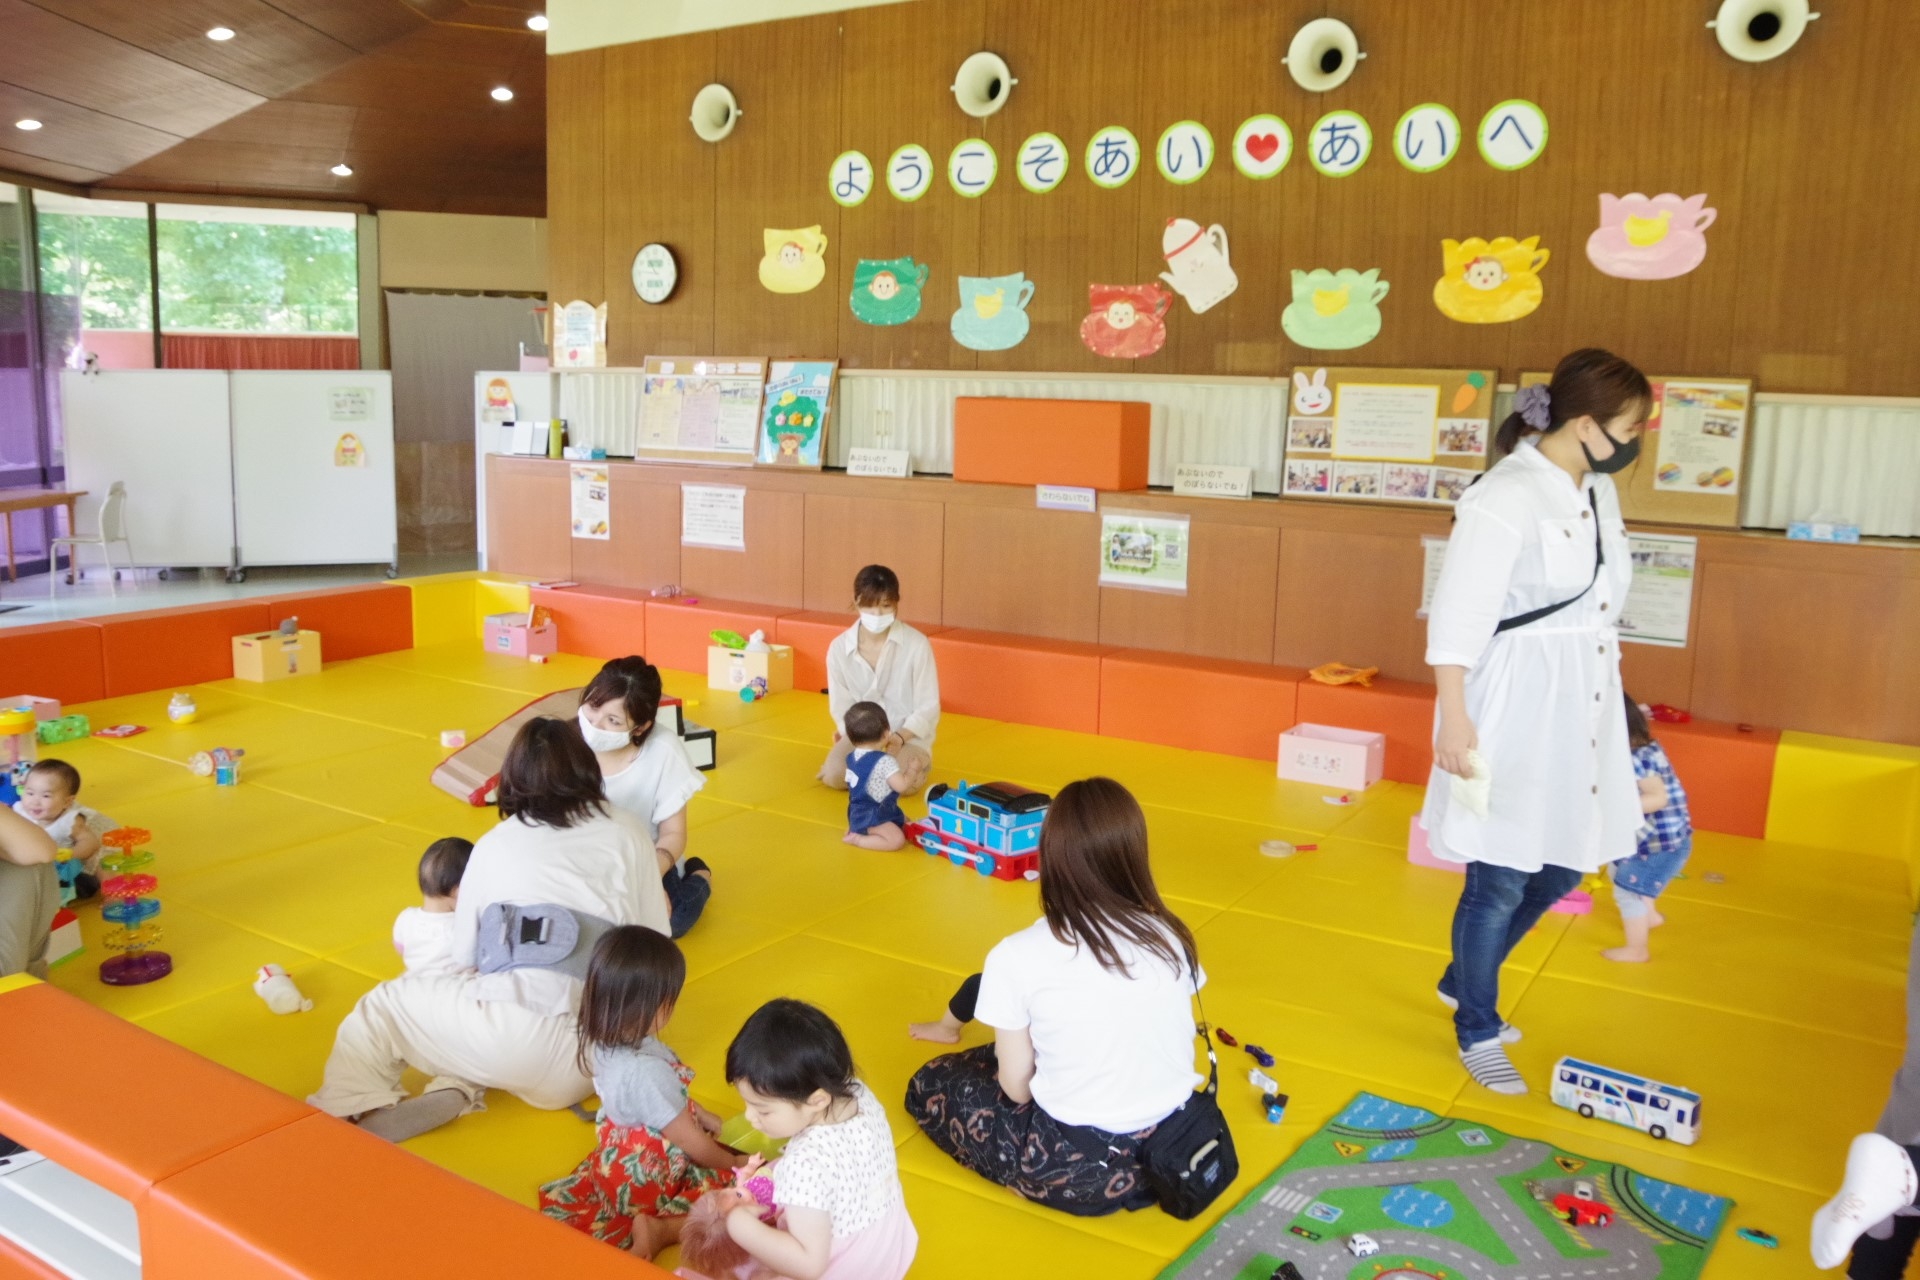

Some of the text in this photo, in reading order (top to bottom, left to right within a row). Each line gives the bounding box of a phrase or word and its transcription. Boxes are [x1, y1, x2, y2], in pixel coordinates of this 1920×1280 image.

[1177, 468, 1224, 479] あぶないので
[1041, 492, 1090, 503] さわらないでね
[955, 818, 963, 834] 1
